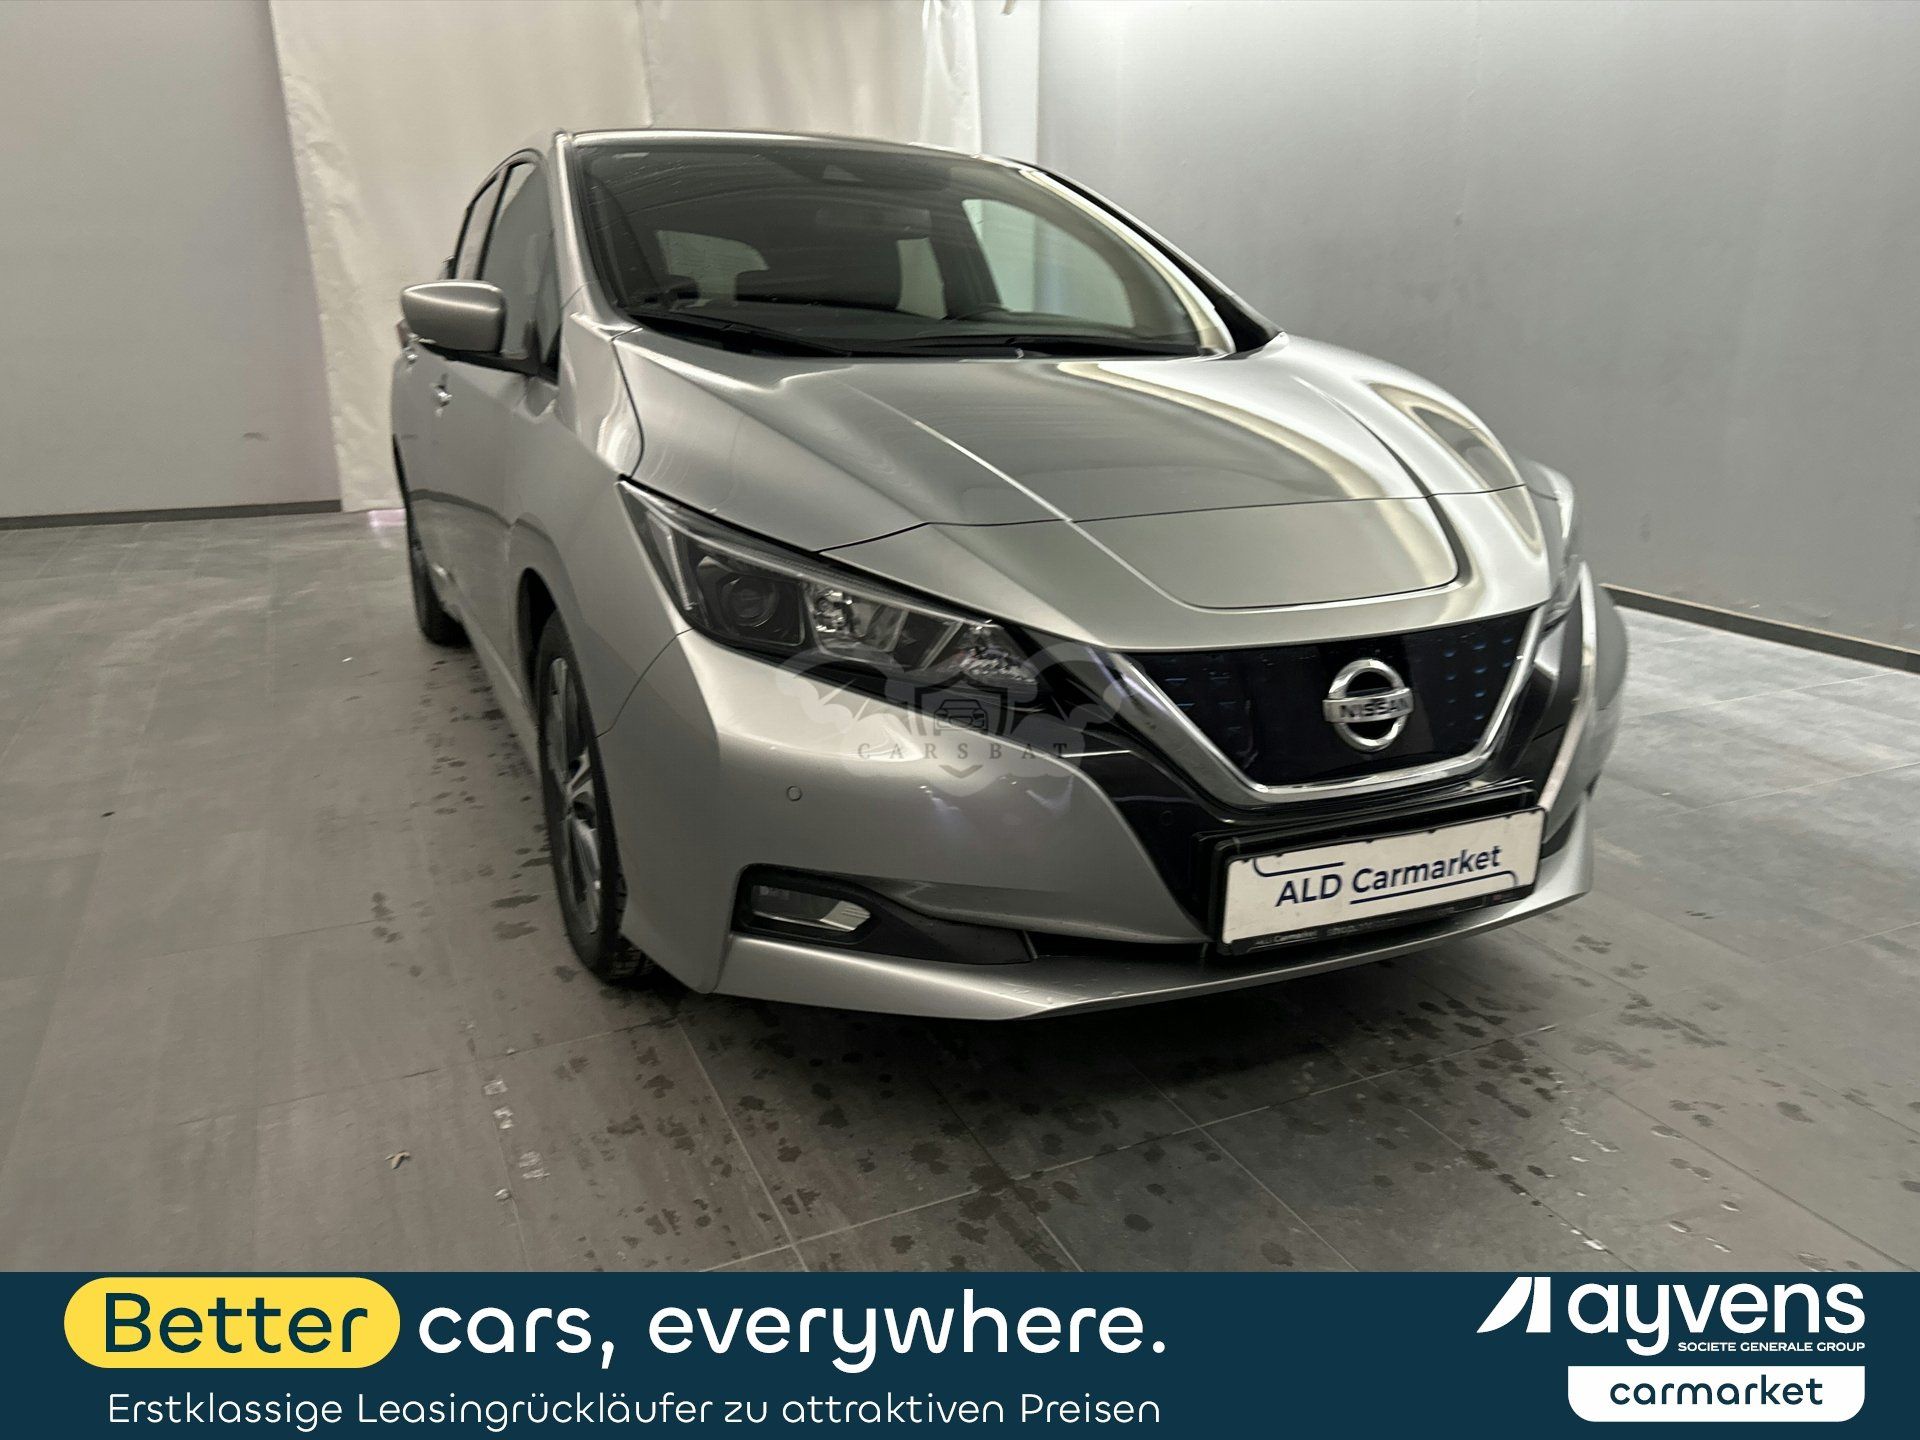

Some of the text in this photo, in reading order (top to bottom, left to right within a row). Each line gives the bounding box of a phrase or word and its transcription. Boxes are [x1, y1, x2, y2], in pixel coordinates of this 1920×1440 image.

[1339, 697, 1409, 719] NISSAN
[1274, 846, 1504, 908] ALD Carmarket
